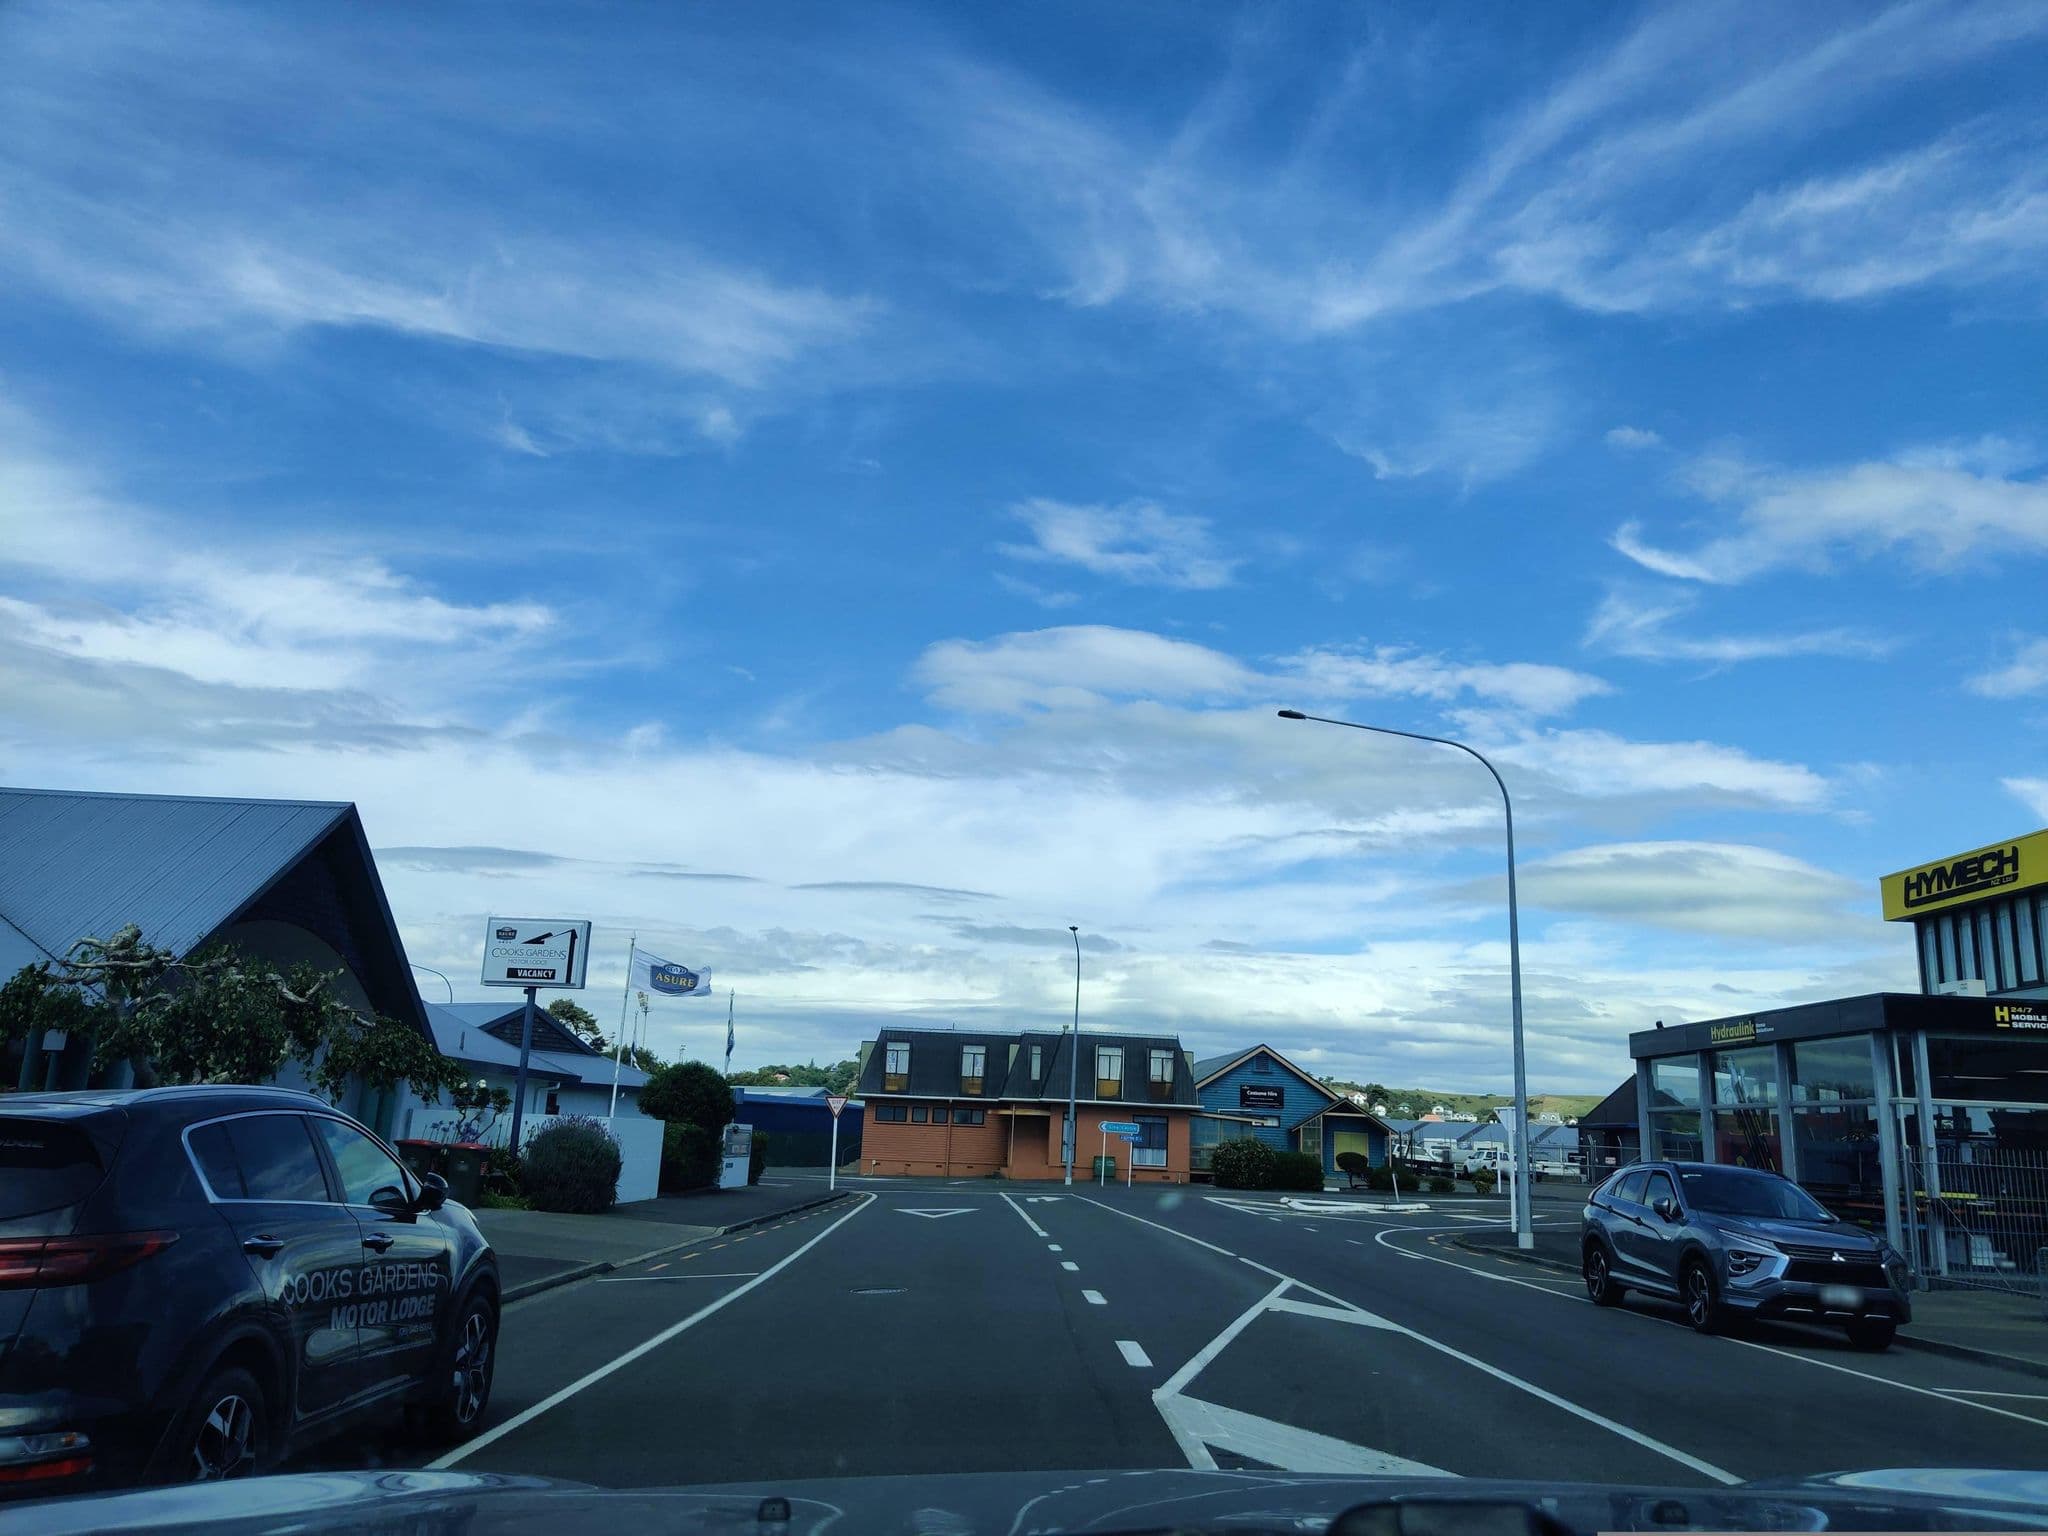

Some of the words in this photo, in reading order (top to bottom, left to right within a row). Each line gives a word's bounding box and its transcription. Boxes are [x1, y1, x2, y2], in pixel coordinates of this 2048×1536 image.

[1904, 846, 2019, 908] HYMECH
[491, 947, 525, 958] COOKS
[525, 948, 567, 960] GARDENS
[517, 969, 554, 978] VACANCY
[655, 971, 695, 988] ASURE
[1711, 1020, 1756, 1040] Hydraulink
[2012, 1021, 2048, 1029] SERVIC
[282, 1268, 353, 1305] COOKS
[359, 1262, 438, 1296] GARDENS
[331, 1301, 387, 1331] MOTOR
[391, 1293, 436, 1321] LODGE
